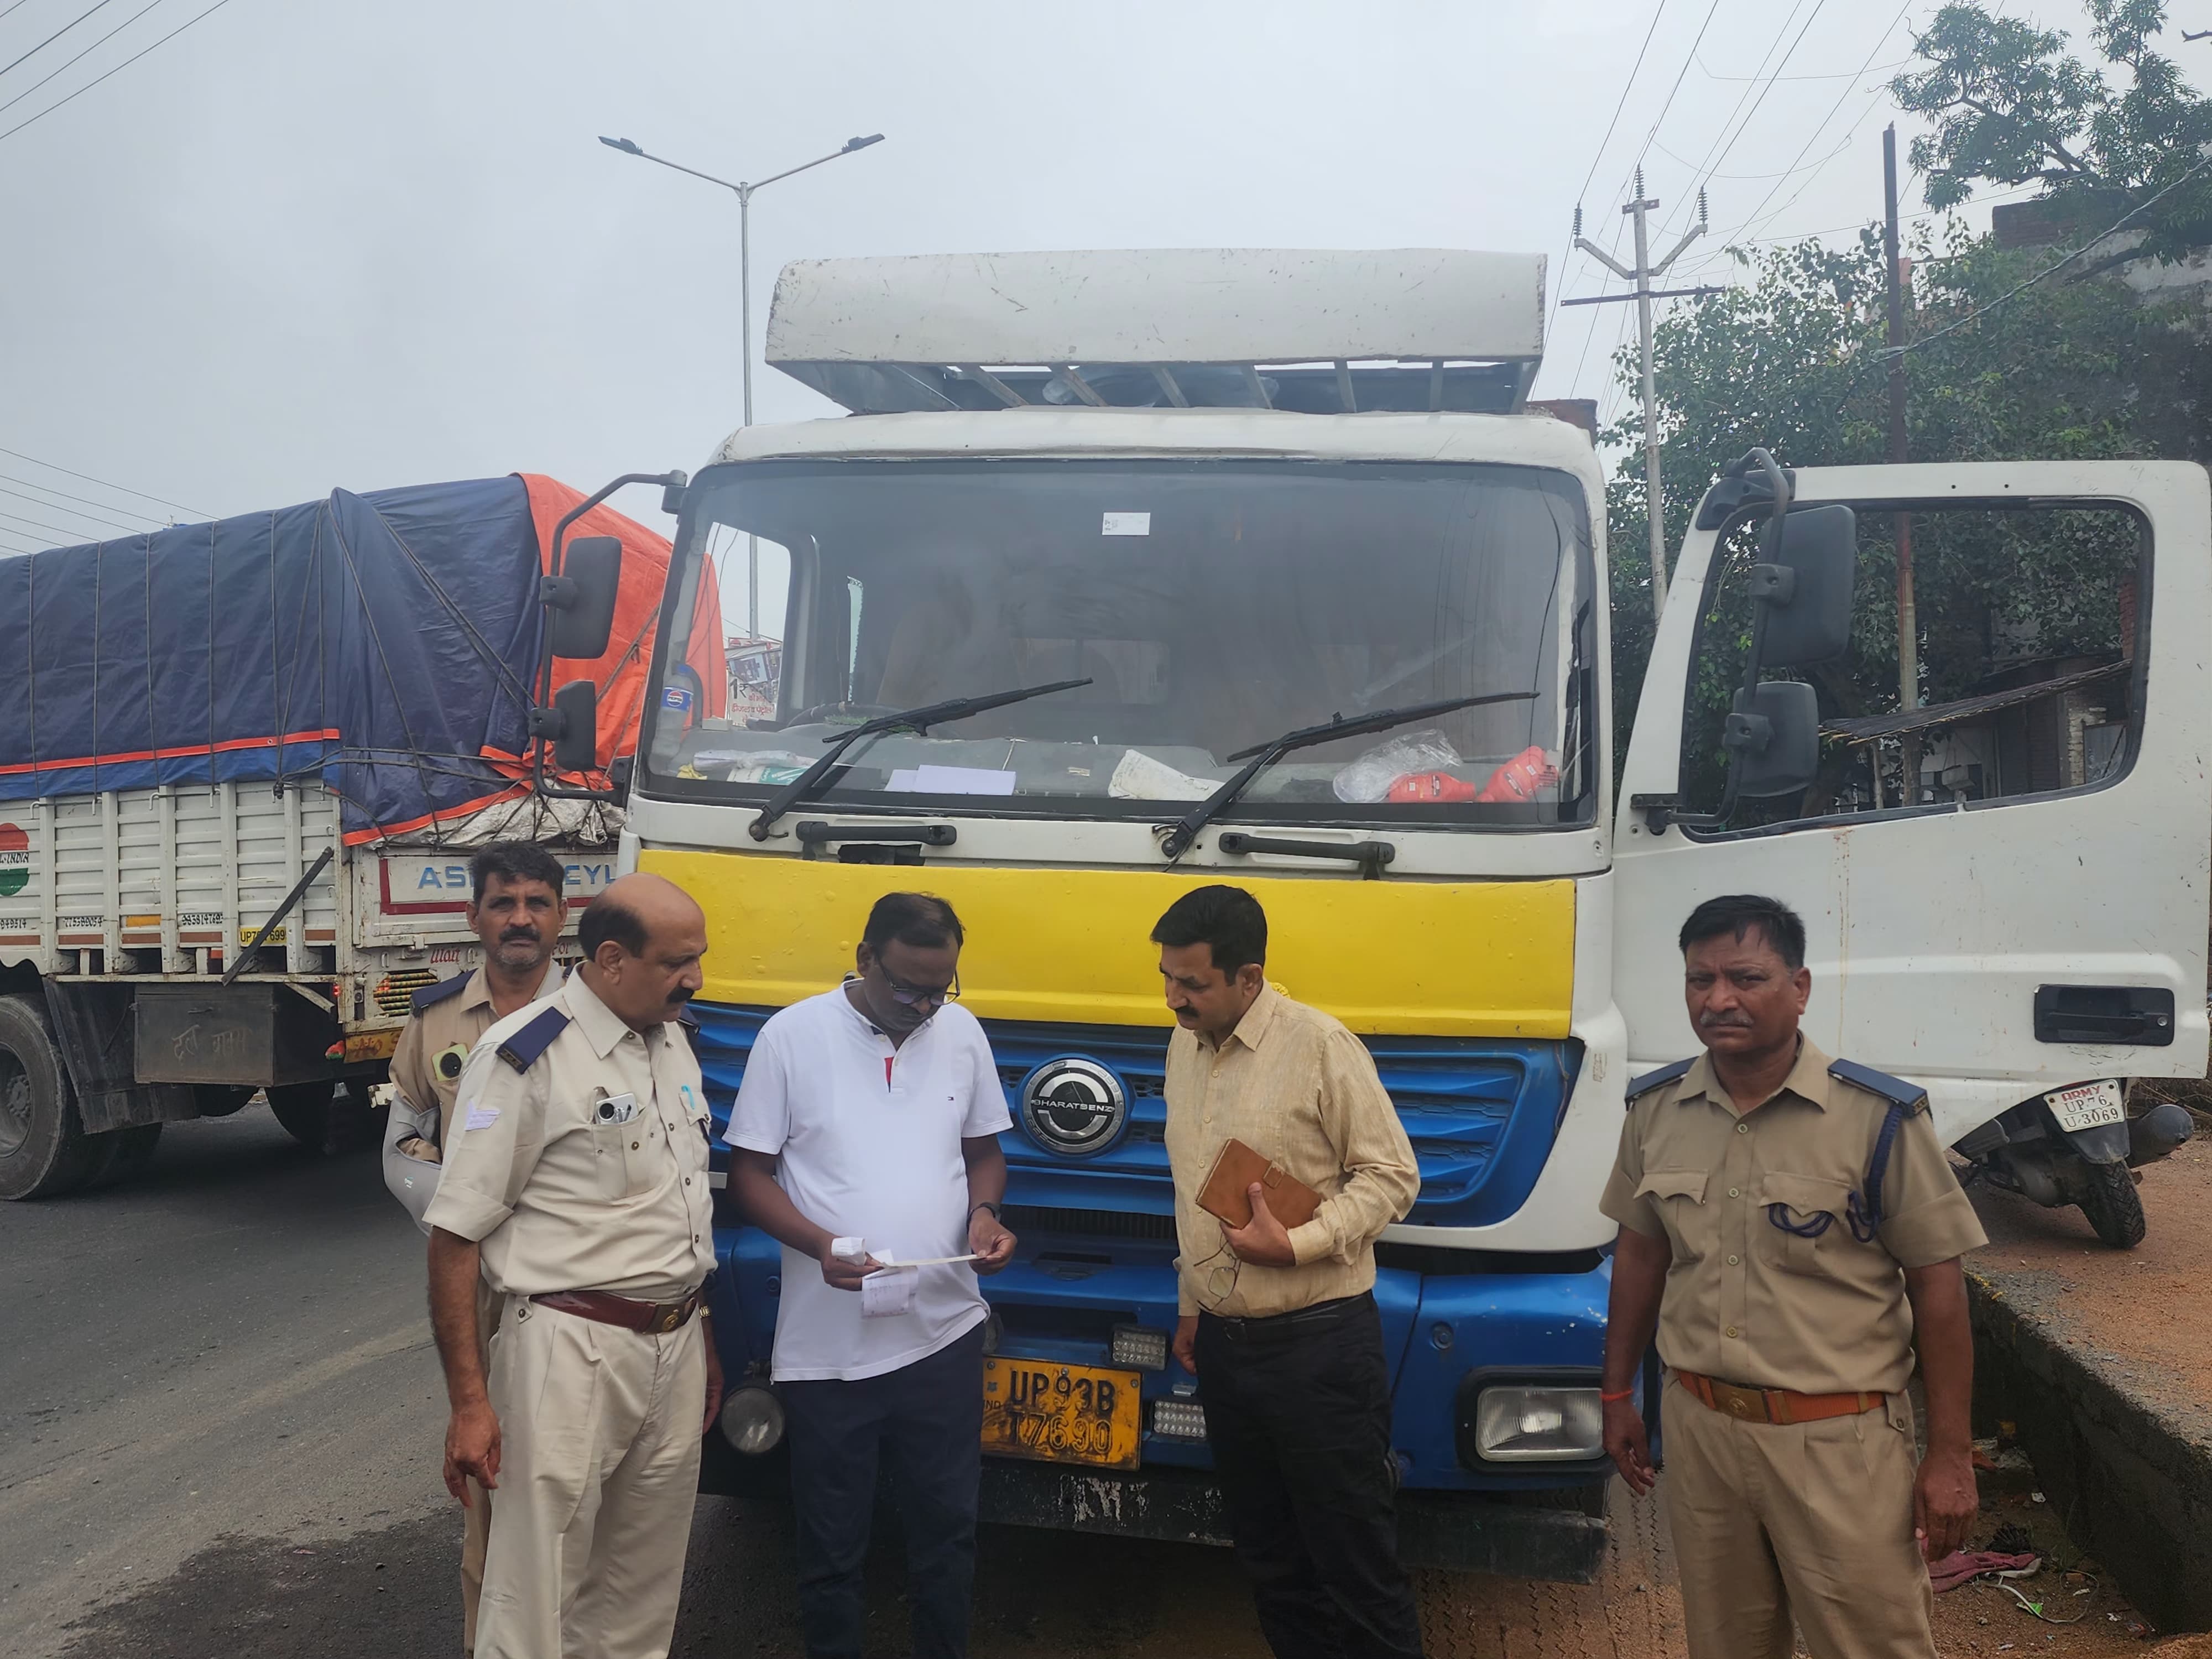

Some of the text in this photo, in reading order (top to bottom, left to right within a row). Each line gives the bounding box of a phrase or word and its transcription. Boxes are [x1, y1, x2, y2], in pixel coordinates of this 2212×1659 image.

[2061, 1086, 2100, 1102] ARMY
[1032, 1098, 1114, 1113] BHARATBENZ
[2064, 1099, 2084, 1113] UP
